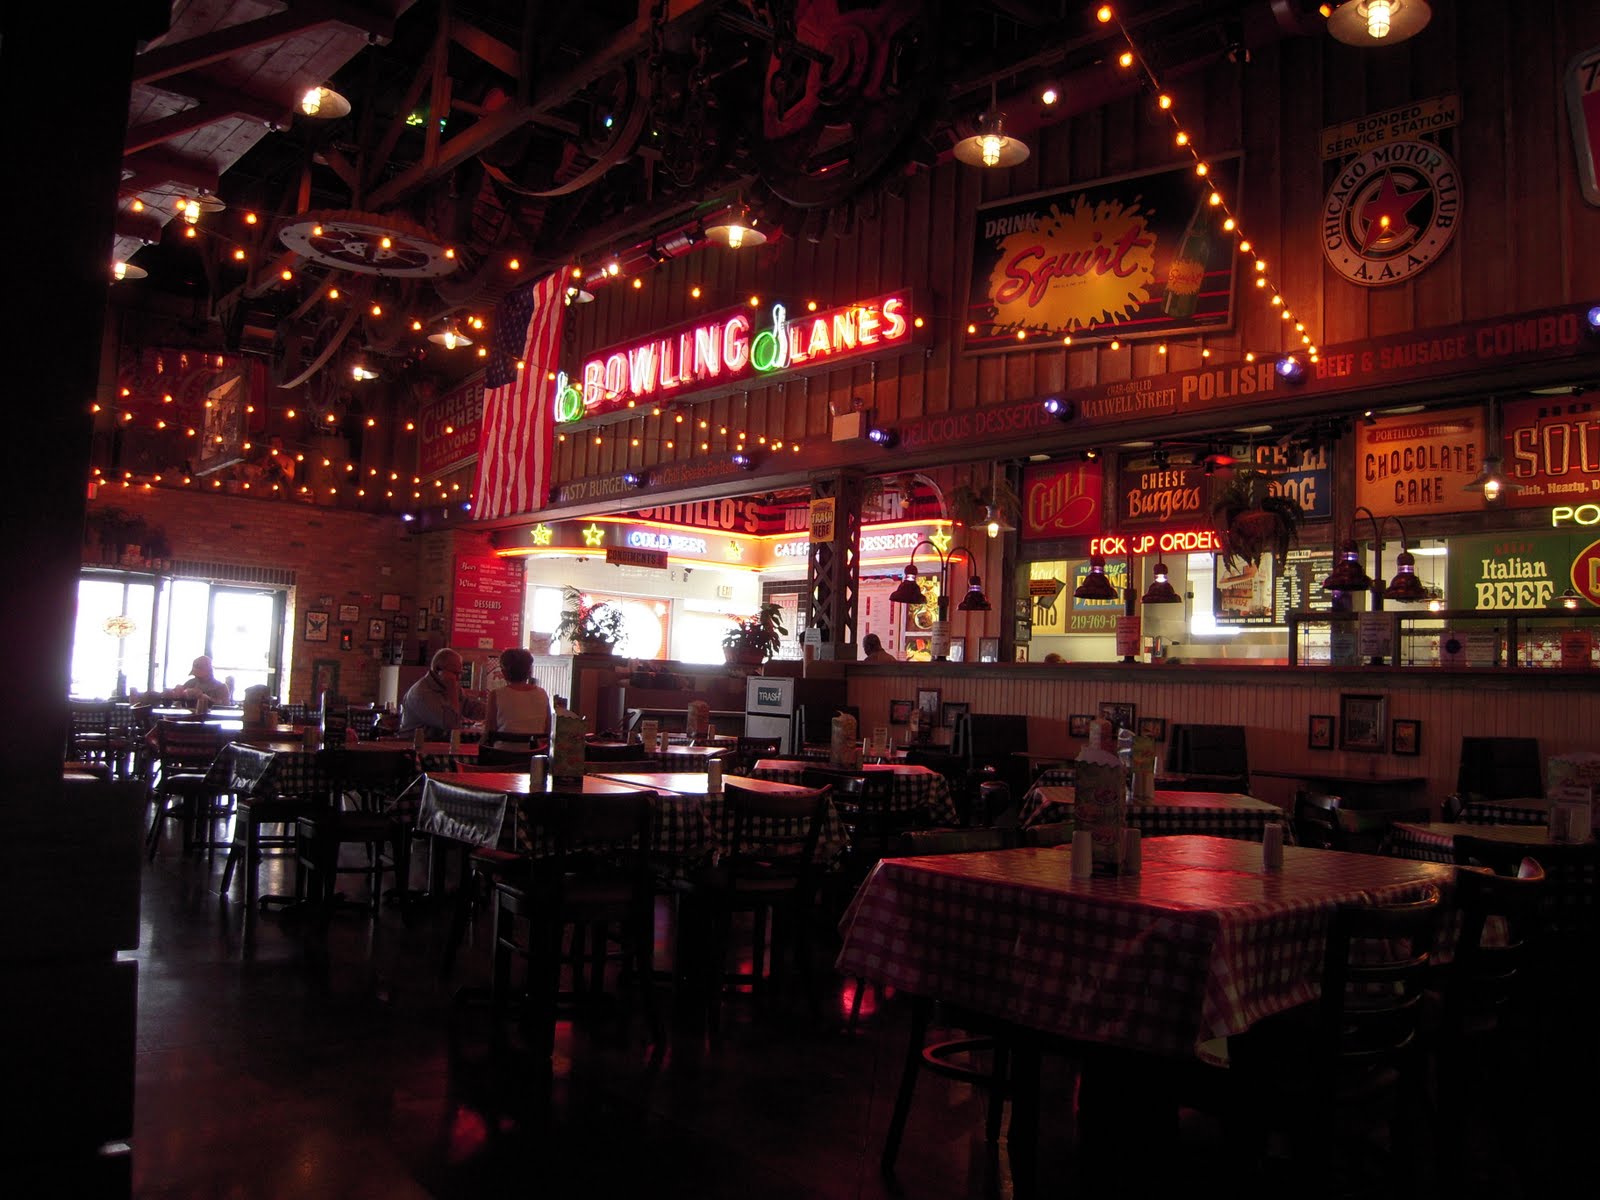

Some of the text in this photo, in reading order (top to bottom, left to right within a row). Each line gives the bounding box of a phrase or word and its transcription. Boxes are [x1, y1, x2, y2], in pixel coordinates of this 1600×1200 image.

[1326, 109, 1455, 156] SERVICE STATION
[1356, 106, 1422, 134] BONDED
[1324, 142, 1458, 251] CHICAGO MOTOR CLUB
[985, 211, 1037, 240] DRINK
[996, 224, 1152, 307] Squirt
[583, 298, 907, 410] BOWLING LANES
[1316, 313, 1579, 380] BEEF & SAUSAGE COMBO
[1081, 363, 1275, 419] MAXWELL STREET POLISH
[901, 416, 970, 446] DELICIOUS
[1375, 427, 1425, 442] PORTILLO'S
[1365, 443, 1476, 483] CHOCOLATE
[560, 481, 586, 502] TASTY
[1142, 470, 1186, 490] CHEESE
[1395, 477, 1443, 504] CAKE
[811, 510, 833, 525] TRASH
[1128, 486, 1200, 522] Burgers
[629, 531, 707, 554] COLD BEER
[813, 524, 830, 538] HERE
[608, 549, 657, 565] CONDIMENTS
[1481, 557, 1547, 580] Italian
[474, 599, 502, 610] DESSERTS
[1475, 580, 1554, 610] BEEF
[759, 690, 781, 702] TRASH
